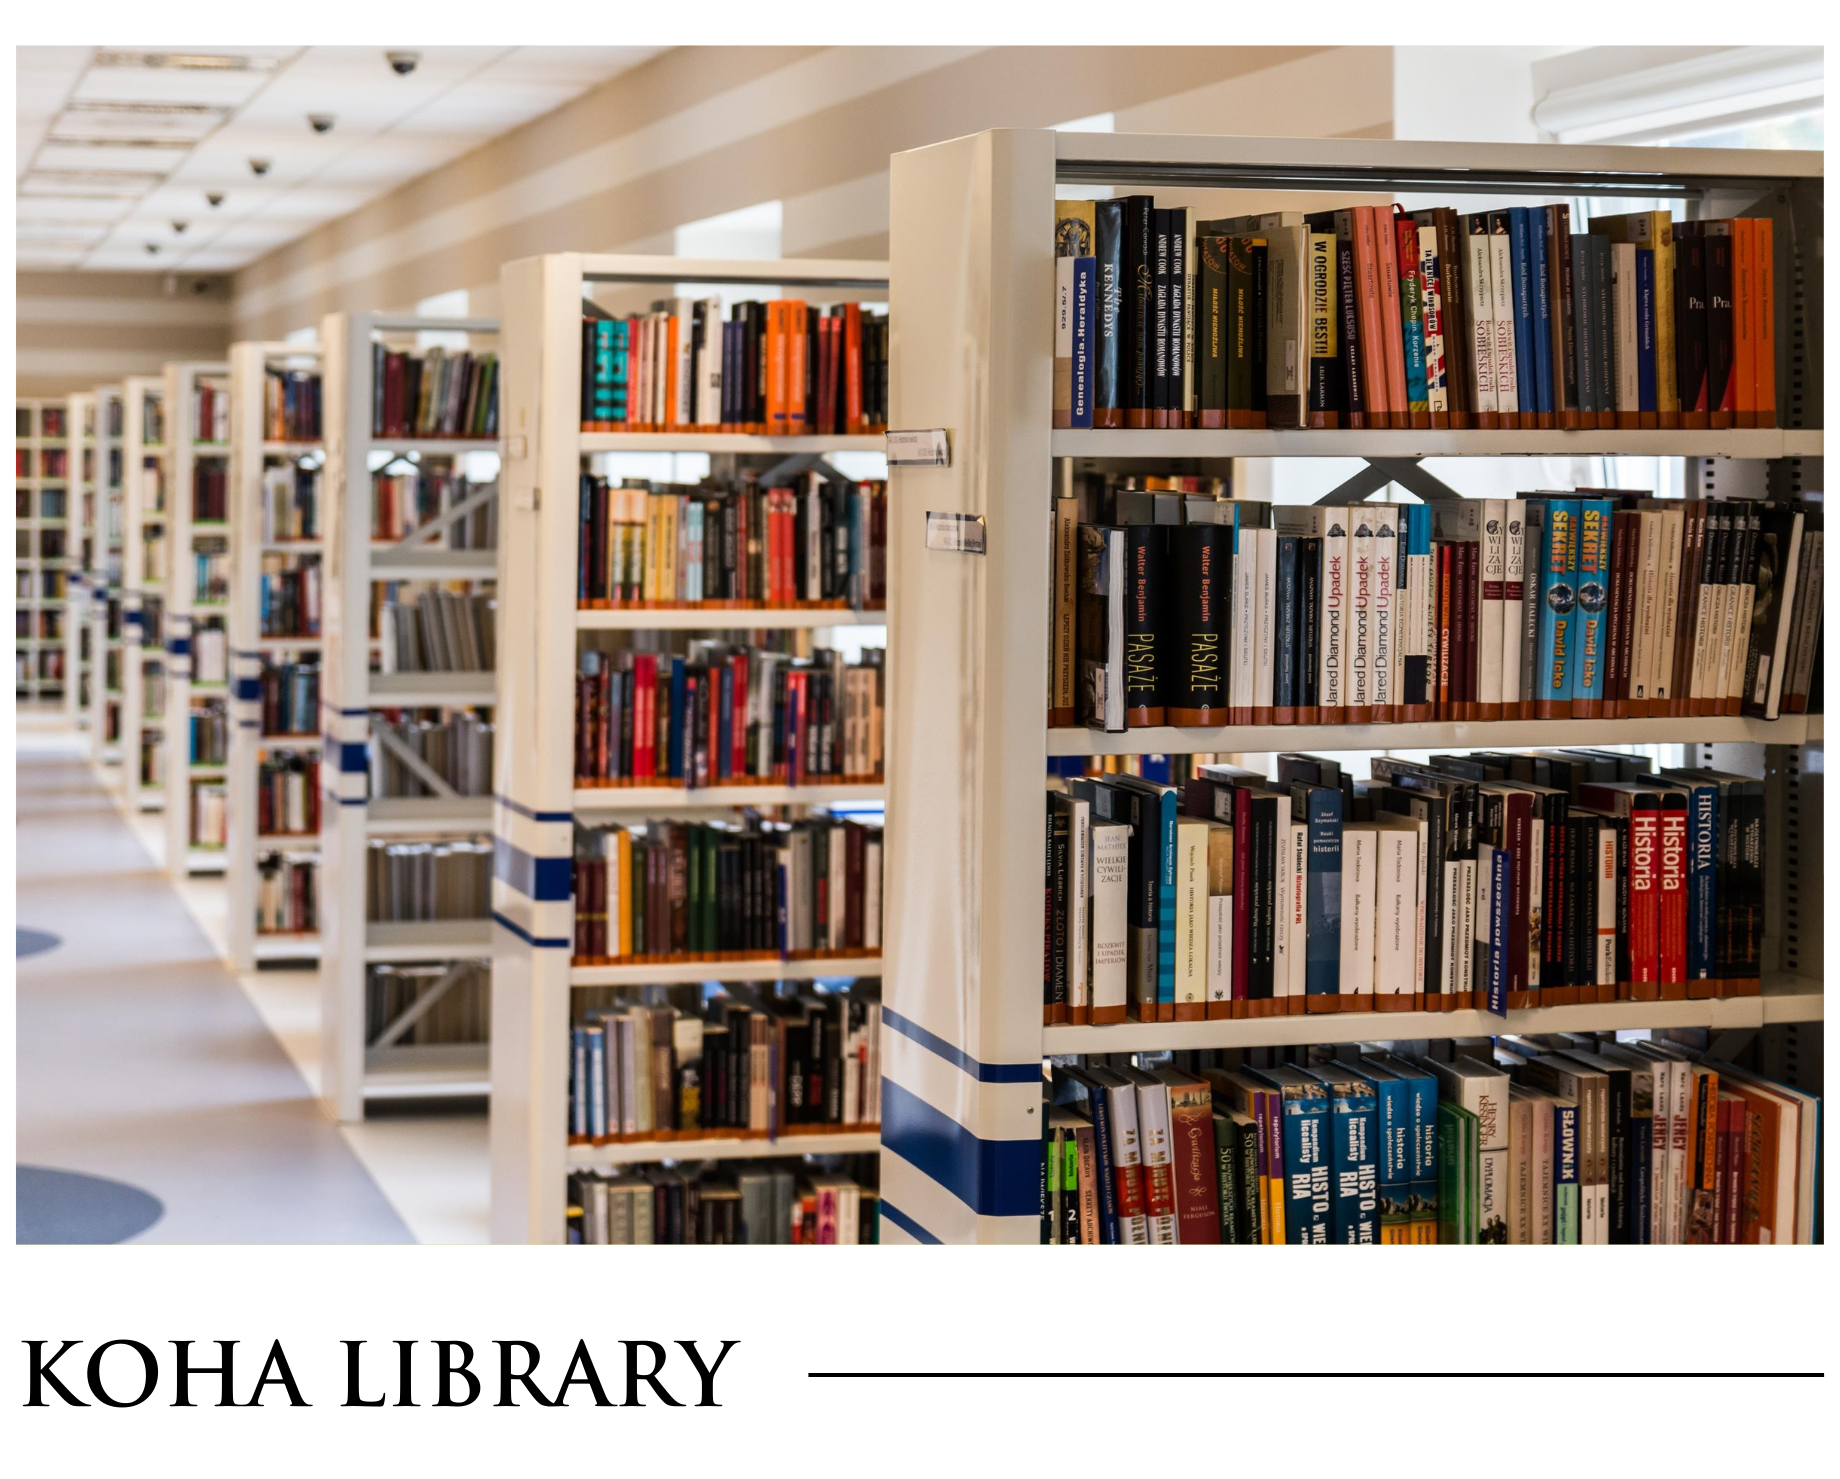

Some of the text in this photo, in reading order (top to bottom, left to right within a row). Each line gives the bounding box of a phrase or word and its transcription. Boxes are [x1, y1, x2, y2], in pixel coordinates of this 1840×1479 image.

[1158, 234, 1166, 257] ANDREW
[1173, 234, 1182, 257] ANDREW
[1158, 259, 1166, 275] COOK
[1173, 259, 1182, 274] COOK
[1367, 263, 1375, 298] Stuartowie
[1386, 262, 1394, 298] Stuartowie
[1408, 270, 1417, 303] Fryderyk
[1425, 250, 1434, 286] TAJEMNICE
[1445, 264, 1453, 302] Burbonowie
[1104, 263, 1113, 337] KENNEDYS
[1114, 287, 1122, 313] The
[1157, 285, 1166, 309] ZAGŁADA
[1173, 284, 1182, 309] ZAGŁADA
[1314, 241, 1328, 354] W OGRODZIE BESTII
[1520, 275, 1529, 318] Bonapartych
[1539, 278, 1548, 319] Bonapartych
[1346, 305, 1355, 339] LUKSUSU
[1076, 272, 1087, 416] Genealogia.Heraldyka
[1476, 320, 1489, 392] SOBIESKICH
[1497, 320, 1509, 392] SOBIESKICH
[1488, 536, 1500, 545] WI
[1488, 556, 1500, 564] ZA
[1490, 546, 1499, 555] LI
[1511, 537, 1522, 545] WI
[1511, 556, 1522, 565] ZA
[1513, 547, 1522, 555] LI
[1550, 510, 1568, 575] SEKRET
[1568, 516, 1577, 571] NAJWIĘKSZY
[1581, 510, 1599, 574] SEKRET
[1599, 516, 1609, 571] NAJWIĘKSZY
[1136, 546, 1146, 621] Walter Benjamin
[1200, 546, 1210, 621] Walter Benjamin
[1485, 565, 1503, 574] CJE
[1508, 566, 1523, 574] CJE
[1646, 570, 1655, 594] Historia
[1667, 572, 1676, 596] Historia
[1528, 573, 1537, 638] OSKAR HALECKI
[1698, 586, 1709, 646] GRANICE HISTORII
[1712, 609, 1720, 634] HISTORII
[1724, 586, 1736, 646] GRANICE HISTORII
[1740, 609, 1748, 634] HISTORII
[1326, 556, 1342, 707] Jared Diamond Upadek
[1353, 556, 1369, 707] Jared Diamond Upadek
[1375, 557, 1390, 705] Jared Diamond Upadek
[1128, 633, 1158, 692] PASAŻE
[1191, 634, 1221, 691] PASAŻE
[1441, 628, 1450, 686] CYWILIZACJE
[1553, 620, 1567, 688] David Icke
[1583, 619, 1598, 687] David Icke
[1313, 845, 1340, 853] historii
[1697, 794, 1712, 870] HISTORIA
[1605, 841, 1614, 878] HISTORIA
[1635, 817, 1657, 890] Historia
[1663, 817, 1684, 890] Historia
[1492, 854, 1503, 1010] Historia powszechna
[1273, 1116, 1281, 1159] repetytorium
[1348, 1118, 1359, 1161] licealisty
[1487, 1103, 1497, 1138] HENRY
[1188, 1127, 1203, 1182] Cywilizacja
[1221, 1148, 1231, 1163] 50
[1300, 1120, 1312, 1163] licealisty
[1397, 1127, 1405, 1169] historia
[1425, 1125, 1433, 1166] historia
[1292, 1174, 1311, 1199] RIA
[1311, 1166, 1329, 1212] HISTO
[1340, 1172, 1357, 1197] RIA
[1358, 1164, 1376, 1211] HISTO
[1484, 1158, 1493, 1213] DYPLOMACJA
[1068, 1210, 1076, 1221] 2
[1521, 1216, 1526, 1228] XX
[1543, 1215, 1548, 1226] XX
